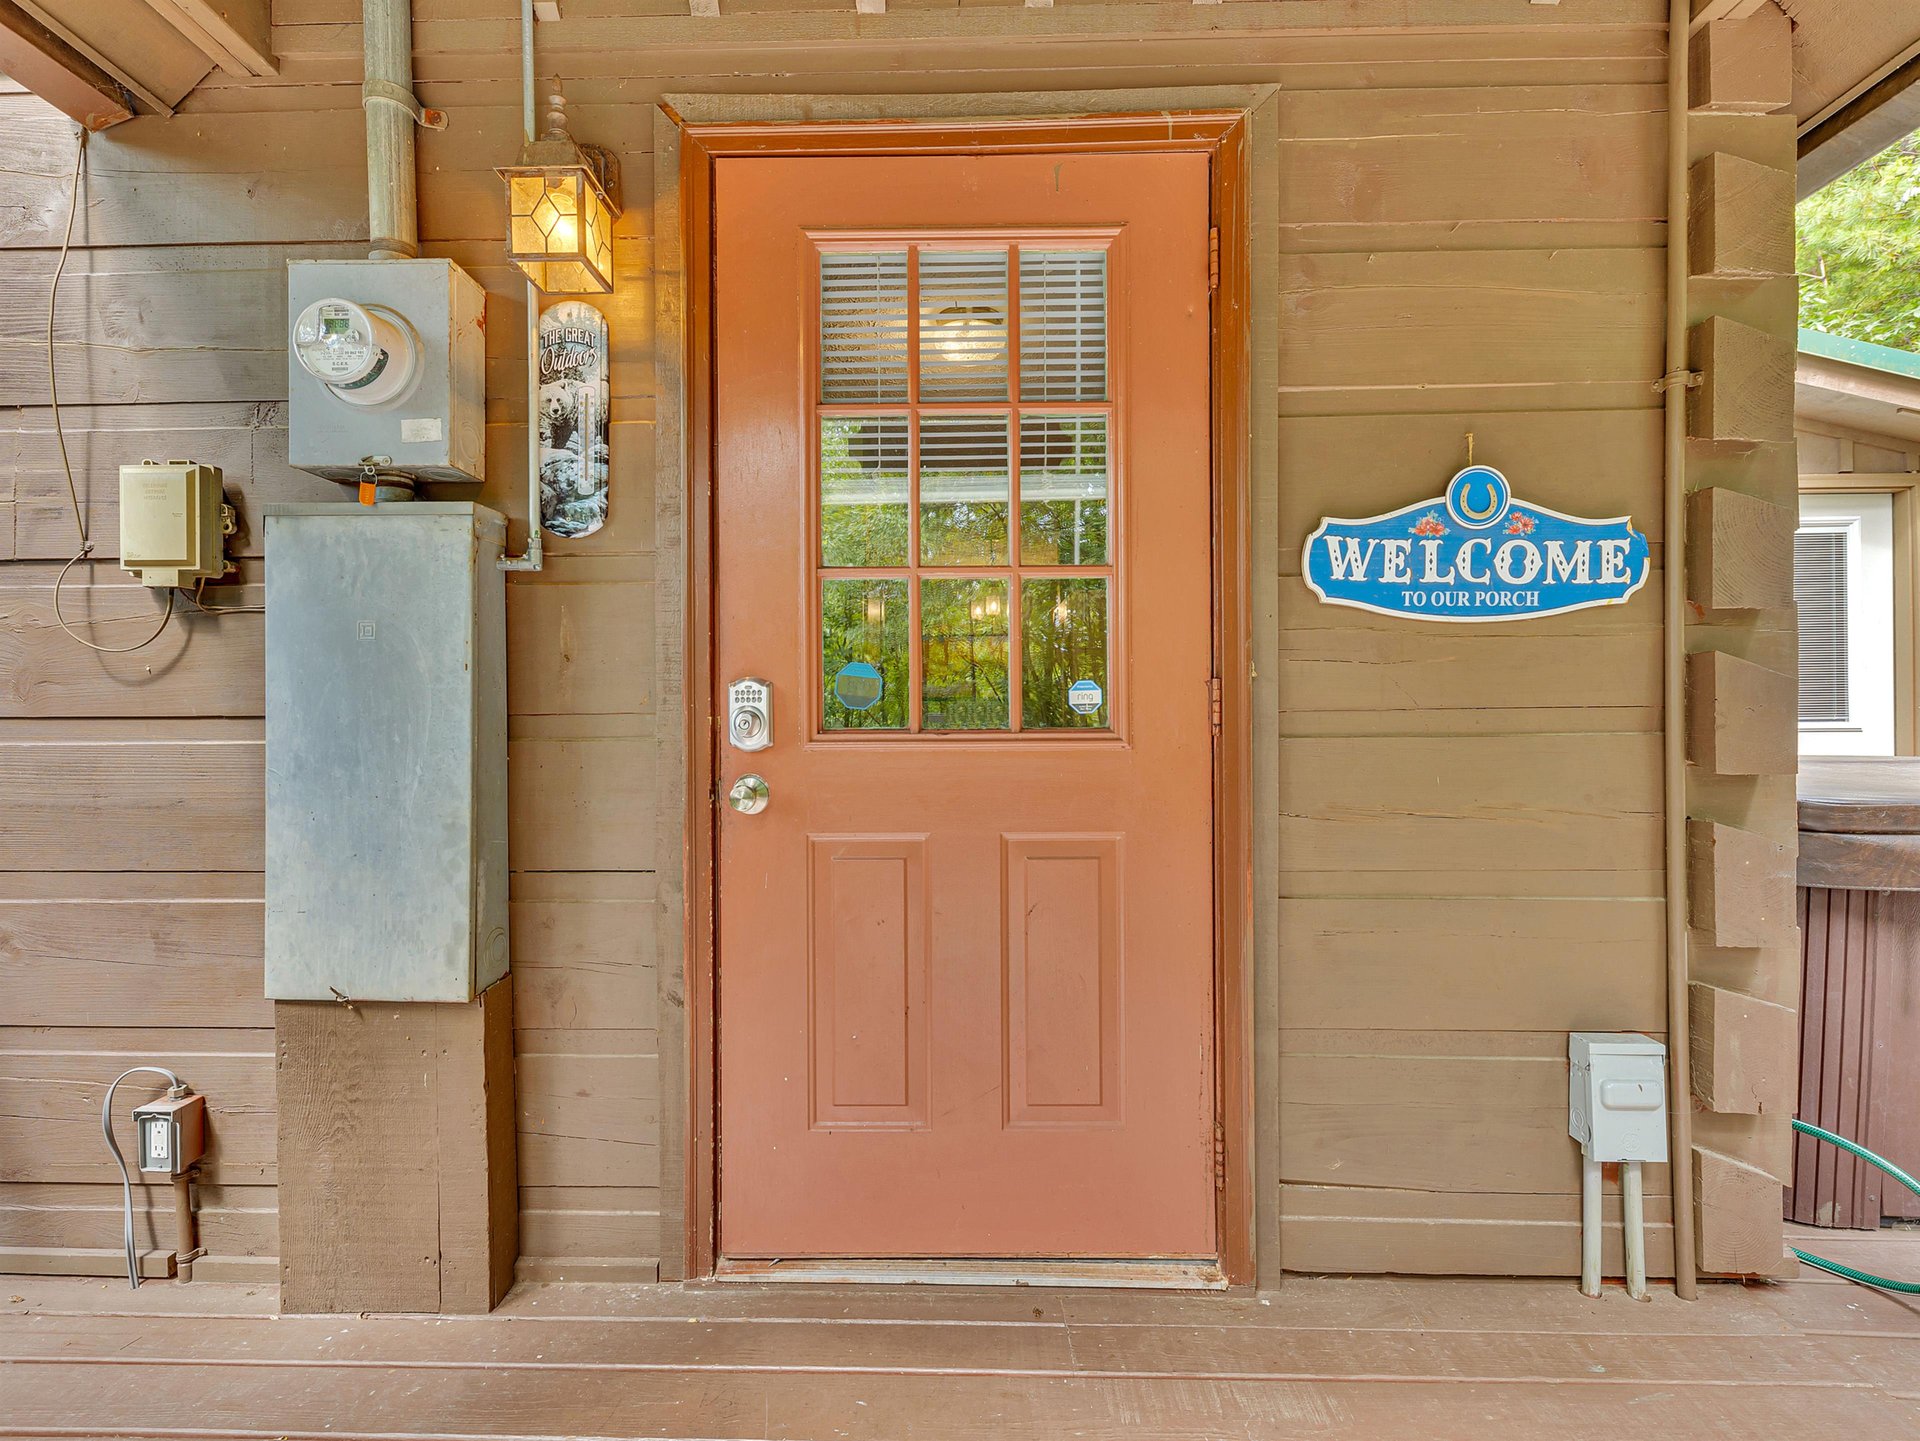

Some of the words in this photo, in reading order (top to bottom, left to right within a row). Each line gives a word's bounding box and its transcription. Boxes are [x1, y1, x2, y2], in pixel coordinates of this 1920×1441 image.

[543, 328, 561, 347] THE
[565, 327, 596, 347] GREAT
[541, 346, 597, 375] Outdoors
[1323, 535, 1632, 586] WELCOME
[1402, 591, 1427, 606] TO
[1431, 591, 1470, 607] OUR
[1474, 591, 1541, 607] PORCH
[1077, 693, 1094, 702] ring
